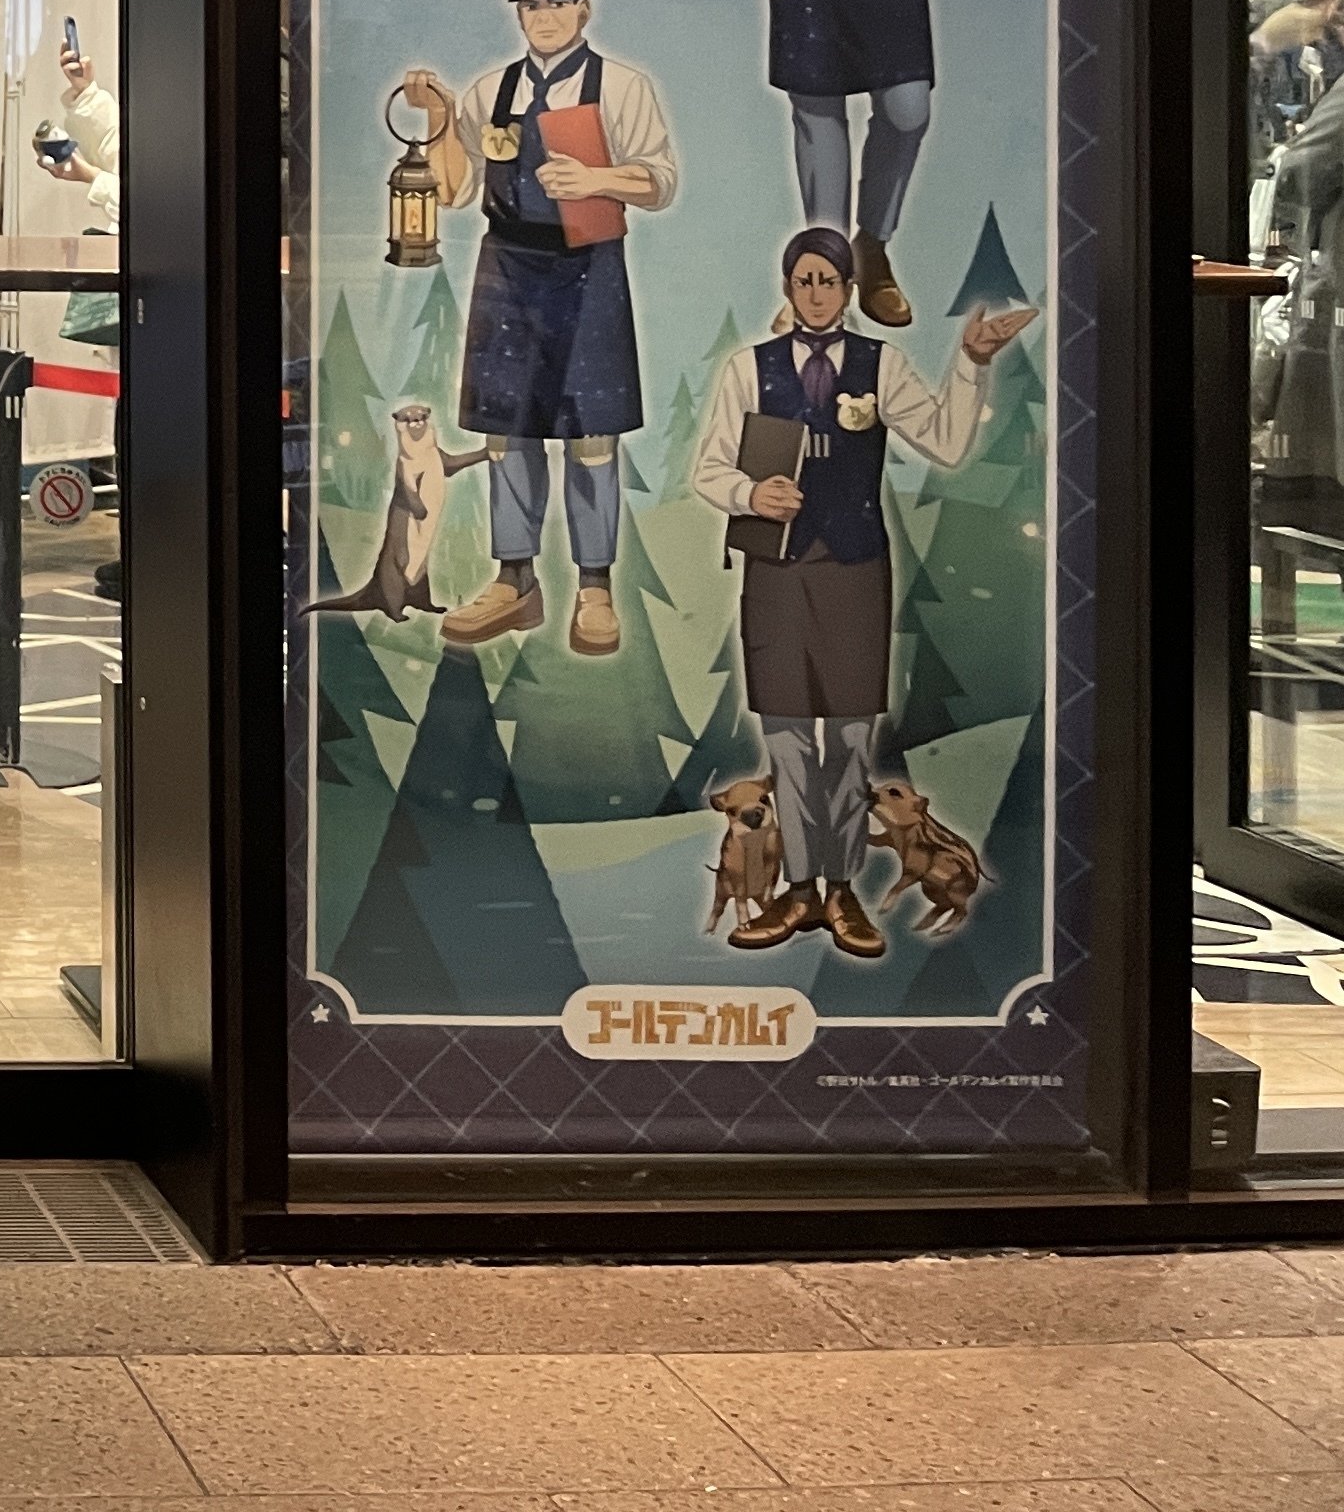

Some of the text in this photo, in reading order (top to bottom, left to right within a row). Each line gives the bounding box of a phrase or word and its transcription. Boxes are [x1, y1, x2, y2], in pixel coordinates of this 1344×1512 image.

[586, 1001, 796, 1047] ゴールデンカムイ
